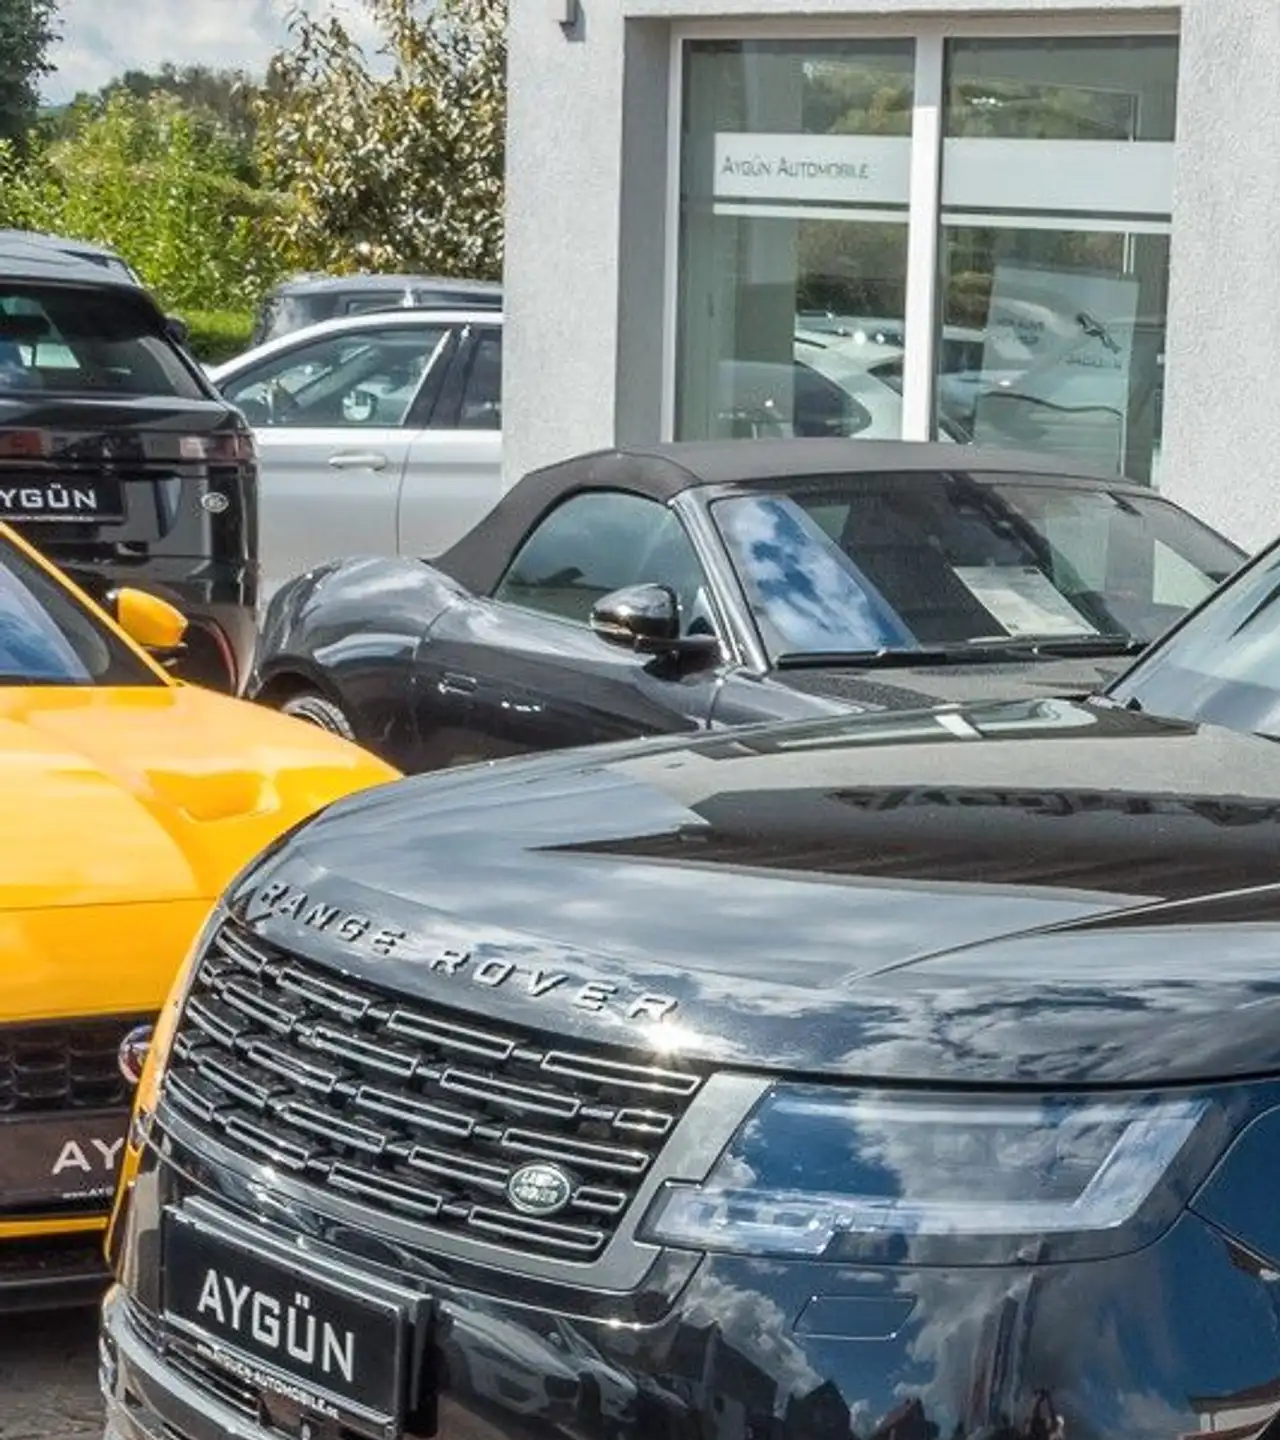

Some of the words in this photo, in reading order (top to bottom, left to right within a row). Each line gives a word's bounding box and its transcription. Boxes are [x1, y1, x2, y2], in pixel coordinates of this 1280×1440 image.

[777, 156, 869, 180] AUTOMOBILE
[260, 882, 406, 956] RANGE
[428, 949, 681, 1023] ROVER
[52, 1138, 124, 1175] AY
[196, 1267, 355, 1383] AYGÜN
